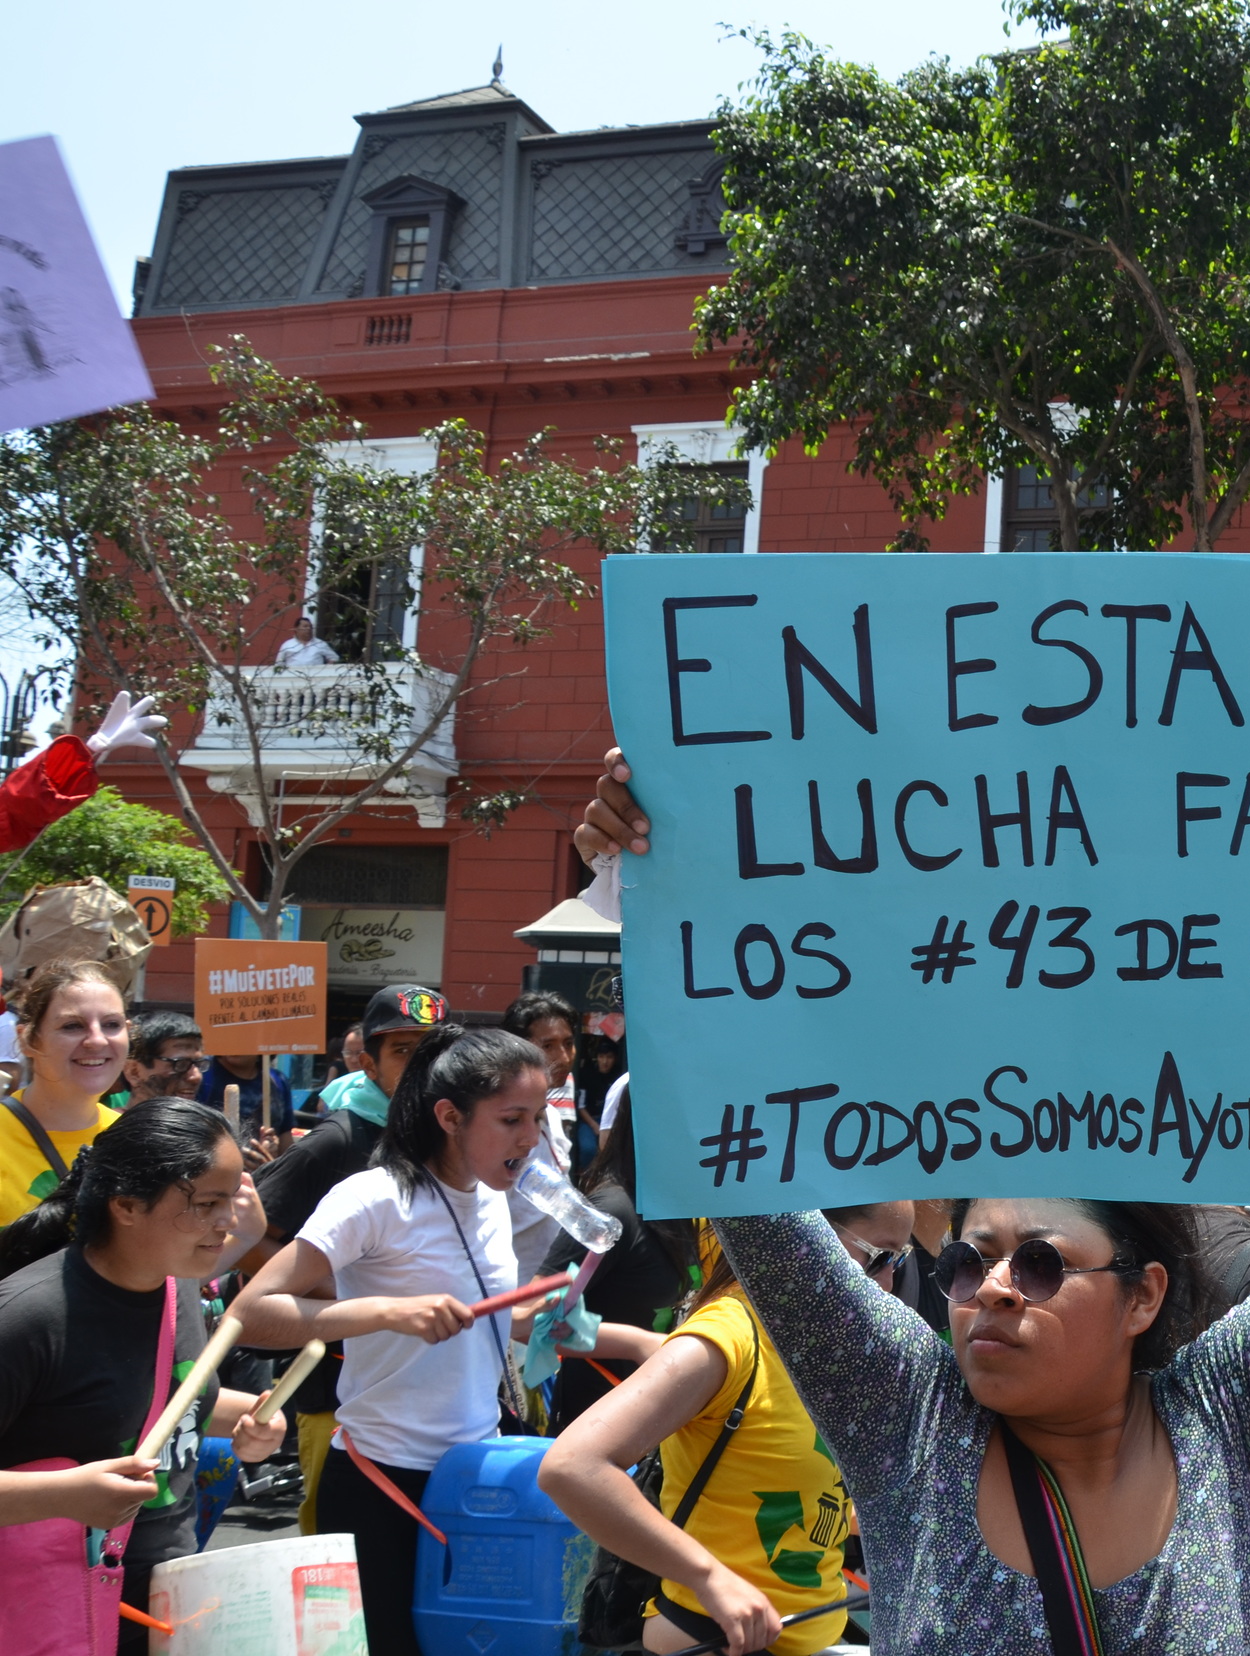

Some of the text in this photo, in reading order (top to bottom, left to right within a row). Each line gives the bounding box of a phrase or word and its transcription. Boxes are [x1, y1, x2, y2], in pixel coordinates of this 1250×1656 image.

[663, 594, 1244, 746] EN ESTA
[734, 765, 1098, 880] LUCHA
[320, 908, 415, 942] Ameesha
[680, 921, 851, 1000] LOS
[911, 900, 1095, 989] #43
[1115, 914, 1223, 981] DE
